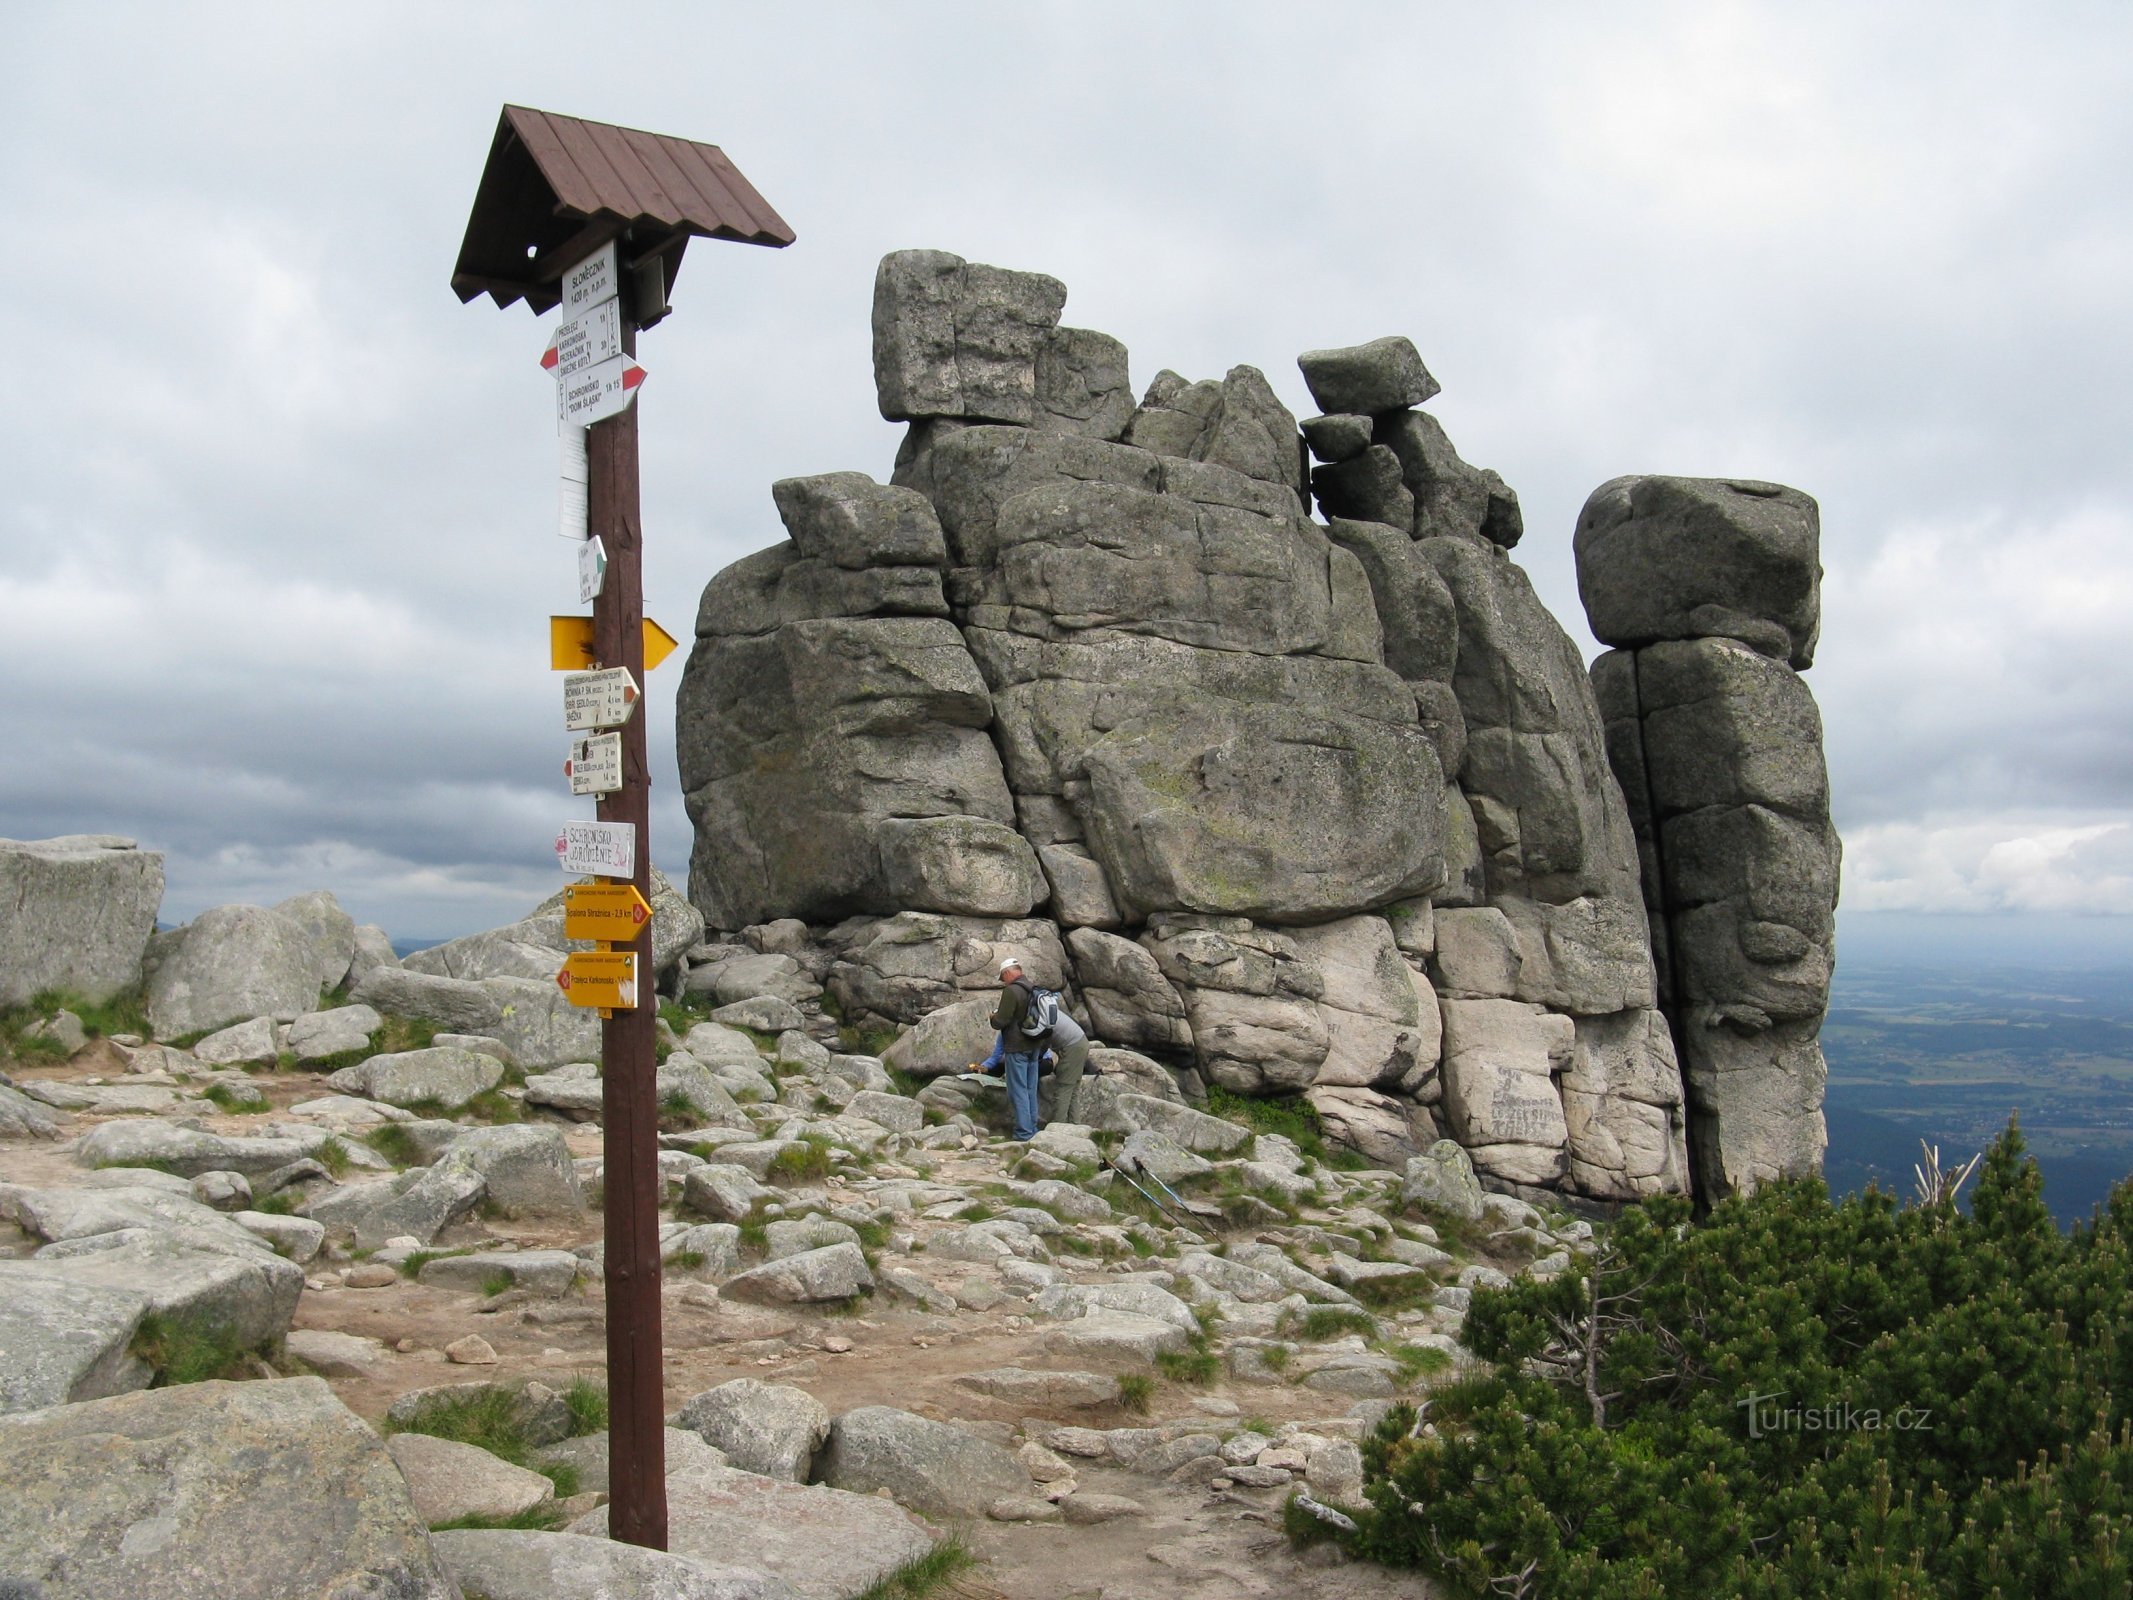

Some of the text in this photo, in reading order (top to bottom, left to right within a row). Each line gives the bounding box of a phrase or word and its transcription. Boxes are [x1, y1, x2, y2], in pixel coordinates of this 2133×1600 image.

[571, 290, 582, 306] 1420
[568, 380, 600, 401] SCHRONISKO
[603, 772, 609, 782] 14
[570, 827, 612, 846] SCHRONISKO
[567, 909, 586, 918] Spalona
[587, 908, 610, 917] Strażnica
[624, 909, 632, 917] km
[588, 976, 614, 984] Karkonoska
